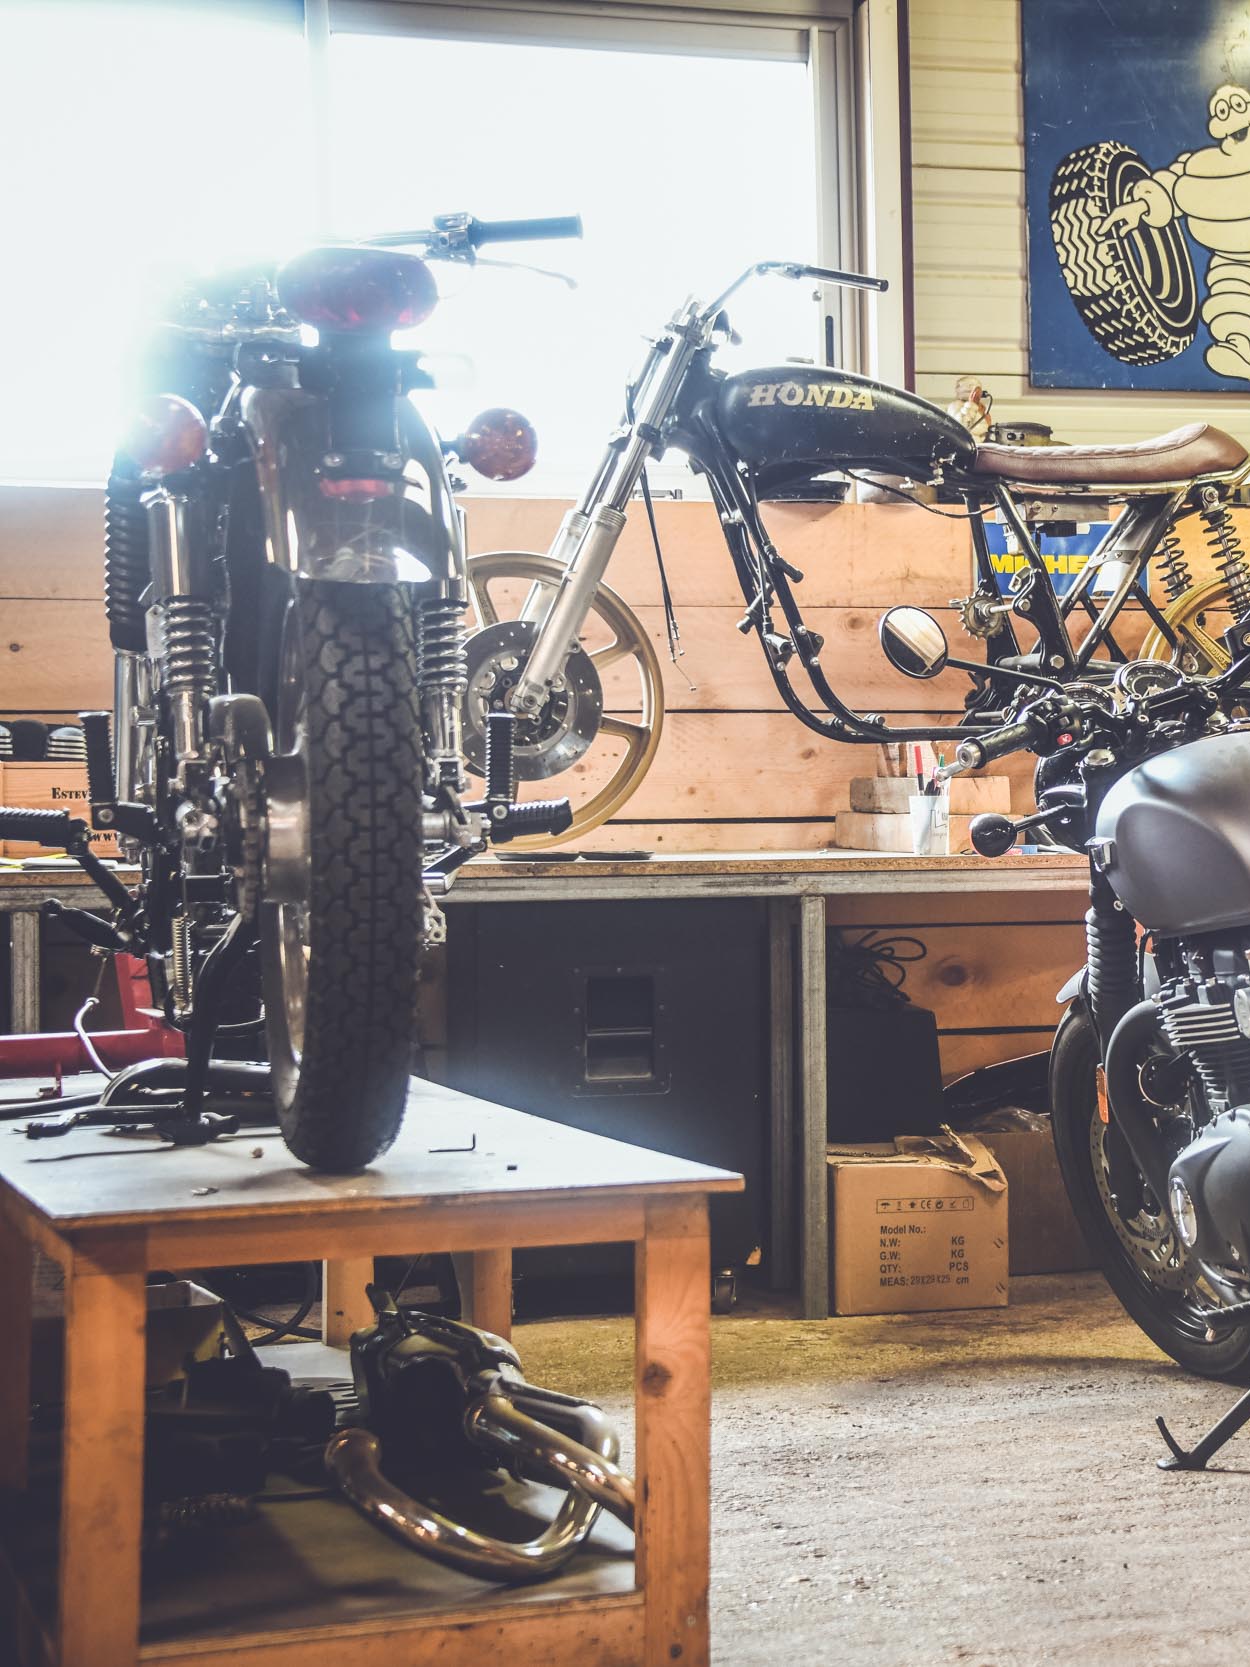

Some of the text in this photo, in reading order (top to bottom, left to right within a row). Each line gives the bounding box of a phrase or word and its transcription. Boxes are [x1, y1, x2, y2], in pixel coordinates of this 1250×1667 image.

[747, 381, 876, 411] HONDA
[51, 787, 90, 800] ESTEV
[880, 1225, 926, 1235] Model No.:
[951, 1236, 965, 1246] KG
[951, 1249, 965, 1259] KG
[880, 1262, 969, 1274] QTY: PCS
[880, 1277, 908, 1287] MEAS:
[956, 1276, 969, 1284] cm
